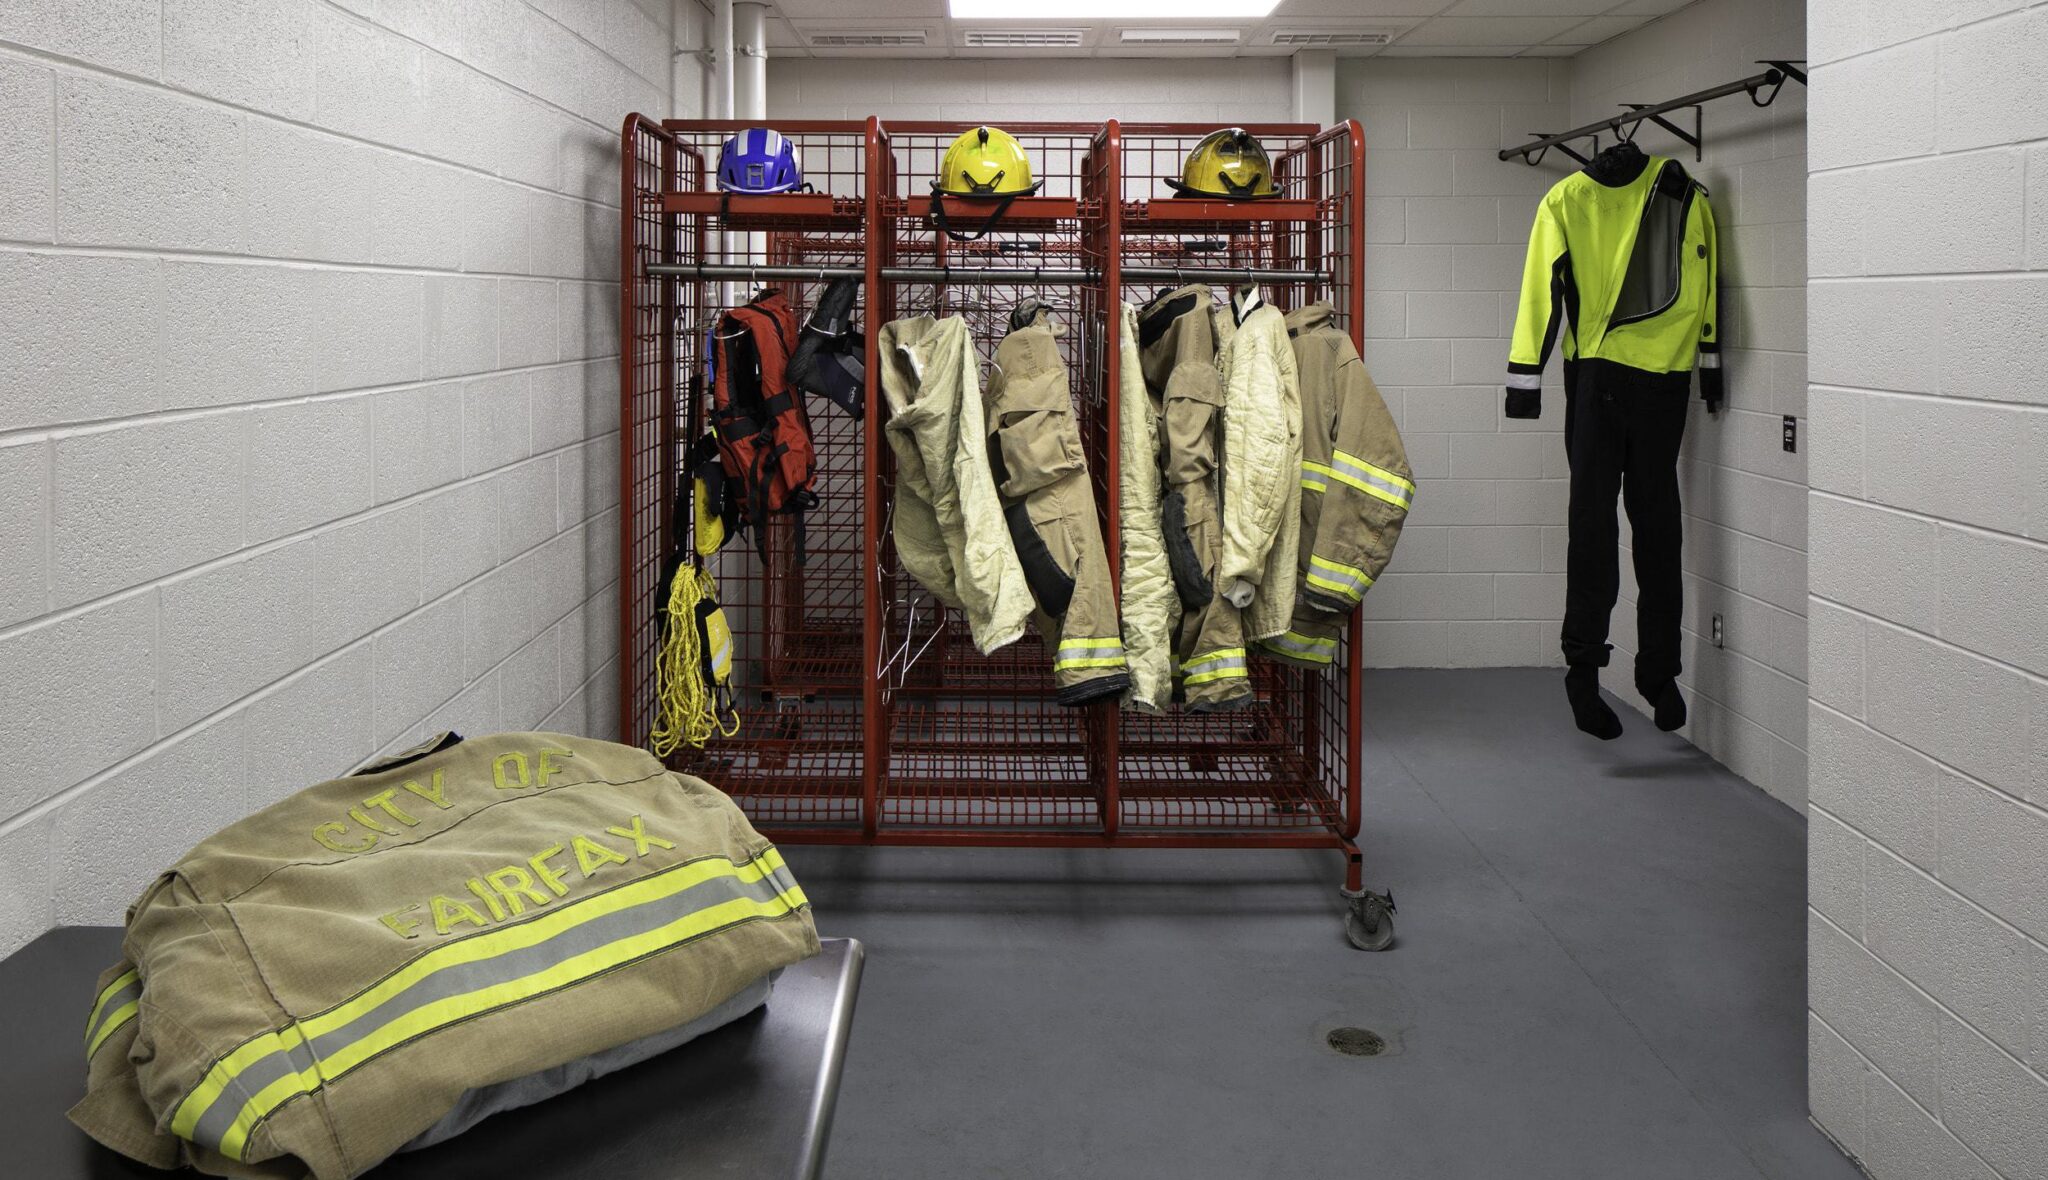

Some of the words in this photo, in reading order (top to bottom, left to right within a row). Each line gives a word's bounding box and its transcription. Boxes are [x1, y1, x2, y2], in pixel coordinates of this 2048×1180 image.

[312, 768, 454, 853] CITY
[491, 748, 574, 790] OF
[378, 813, 677, 939] FAIRFAX
